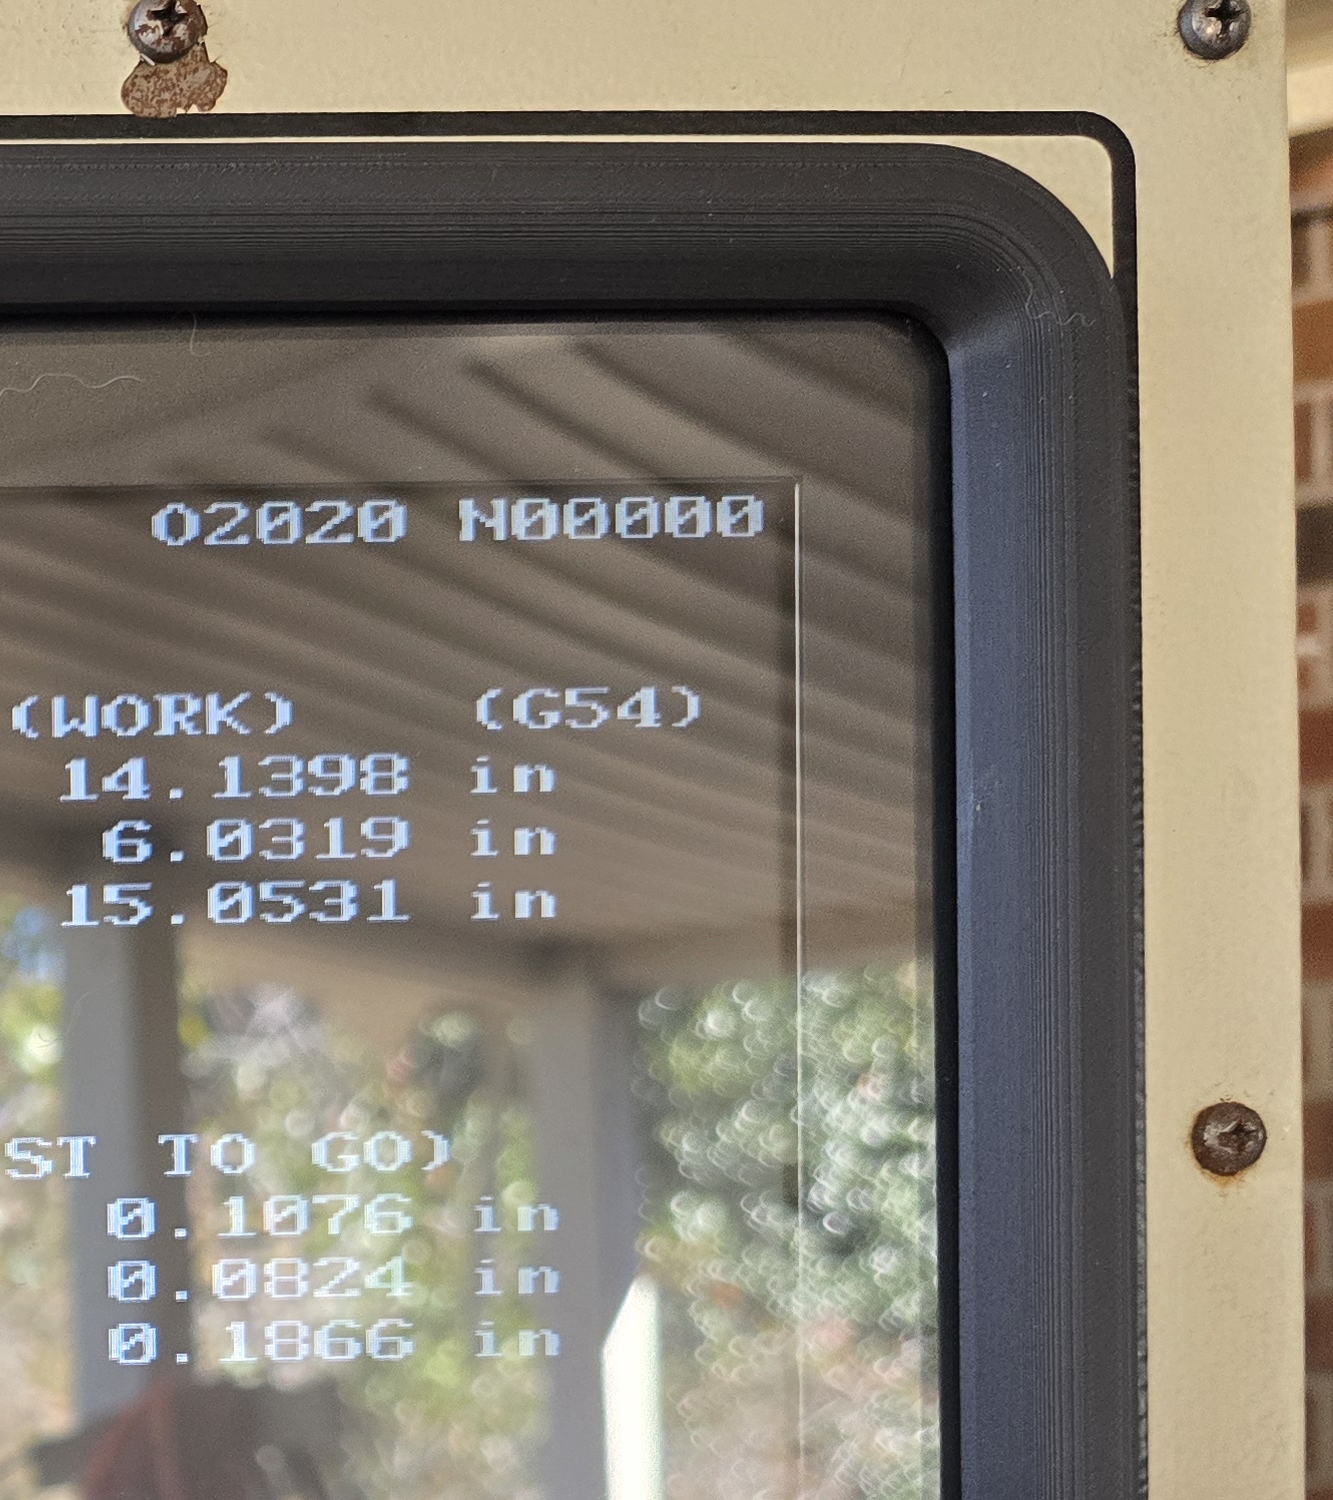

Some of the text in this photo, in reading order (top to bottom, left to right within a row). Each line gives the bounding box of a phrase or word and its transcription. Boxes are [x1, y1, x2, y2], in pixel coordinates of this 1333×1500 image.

[458, 495, 763, 542] N00000
[11, 691, 293, 739] (WORK)
[476, 686, 702, 731] (G54)
[59, 753, 409, 802] 14.1398
[470, 758, 556, 796] in
[102, 816, 410, 864] 6.0319
[470, 820, 557, 859] in
[60, 879, 411, 928] 15.0531
[470, 884, 557, 922] in
[158, 1133, 256, 1176] TO
[311, 1130, 452, 1175] GO)
[106, 1194, 413, 1241] 0.1076
[474, 1196, 560, 1235] in
[107, 1256, 414, 1303] 0.0824
[474, 1259, 561, 1297] in
[108, 1318, 415, 1366] 0.1866
[475, 1321, 561, 1359] in
